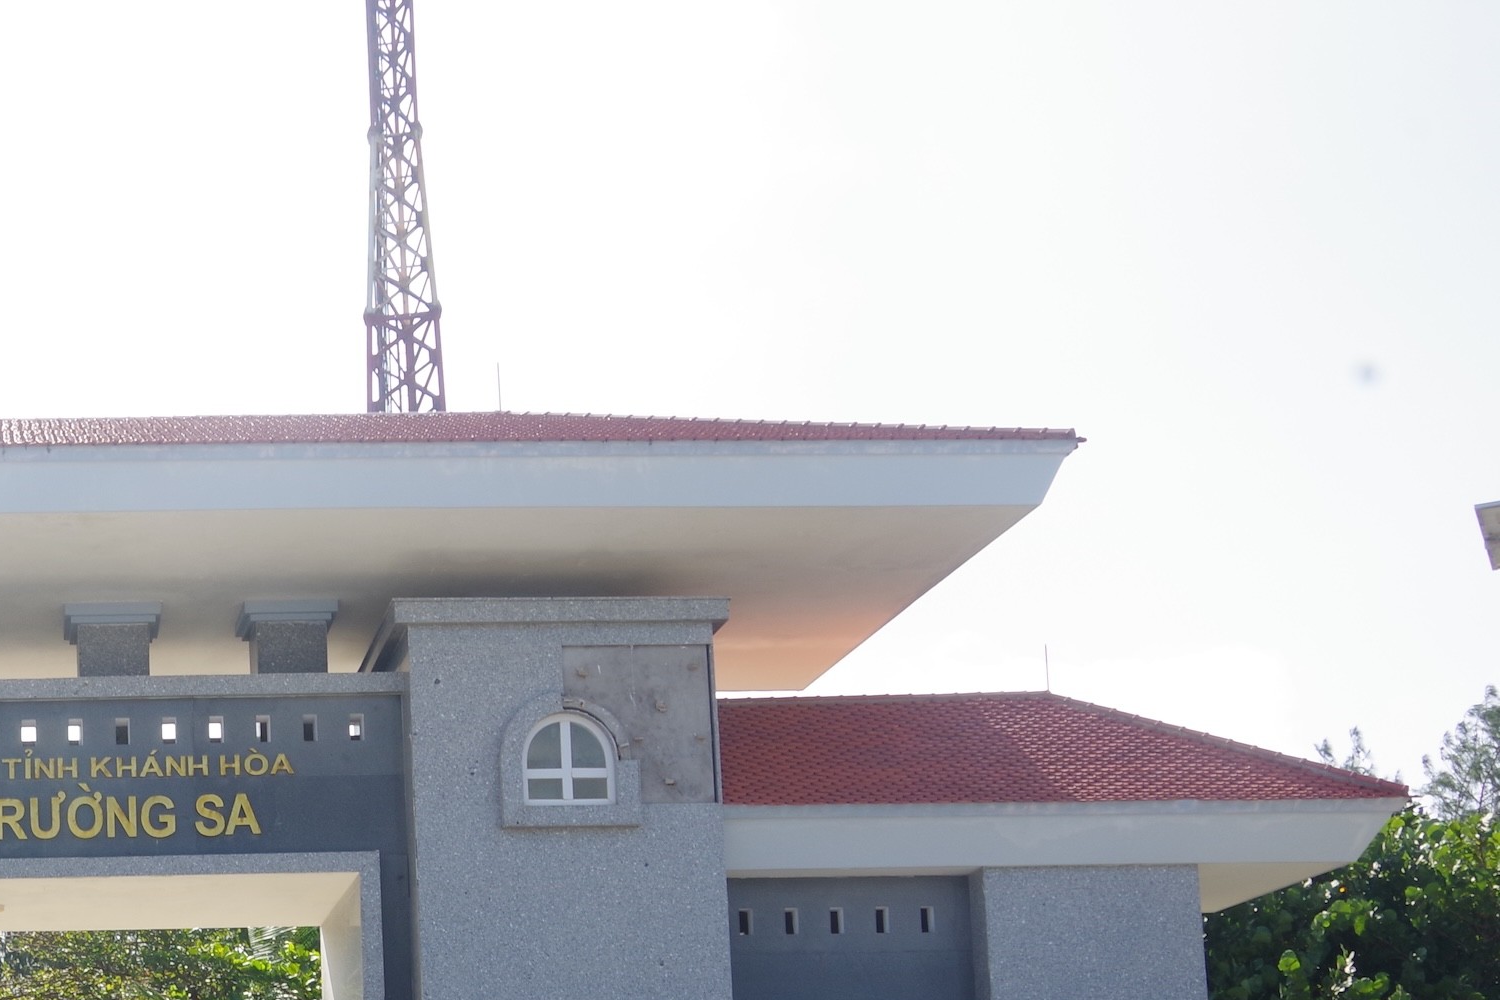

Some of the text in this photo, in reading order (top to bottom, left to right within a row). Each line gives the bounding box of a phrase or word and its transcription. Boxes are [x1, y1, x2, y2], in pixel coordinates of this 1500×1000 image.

[2, 749, 78, 779] TỈNH
[90, 749, 209, 778] KHÁNH
[219, 748, 294, 776] HÒA
[195, 793, 261, 836] SA
